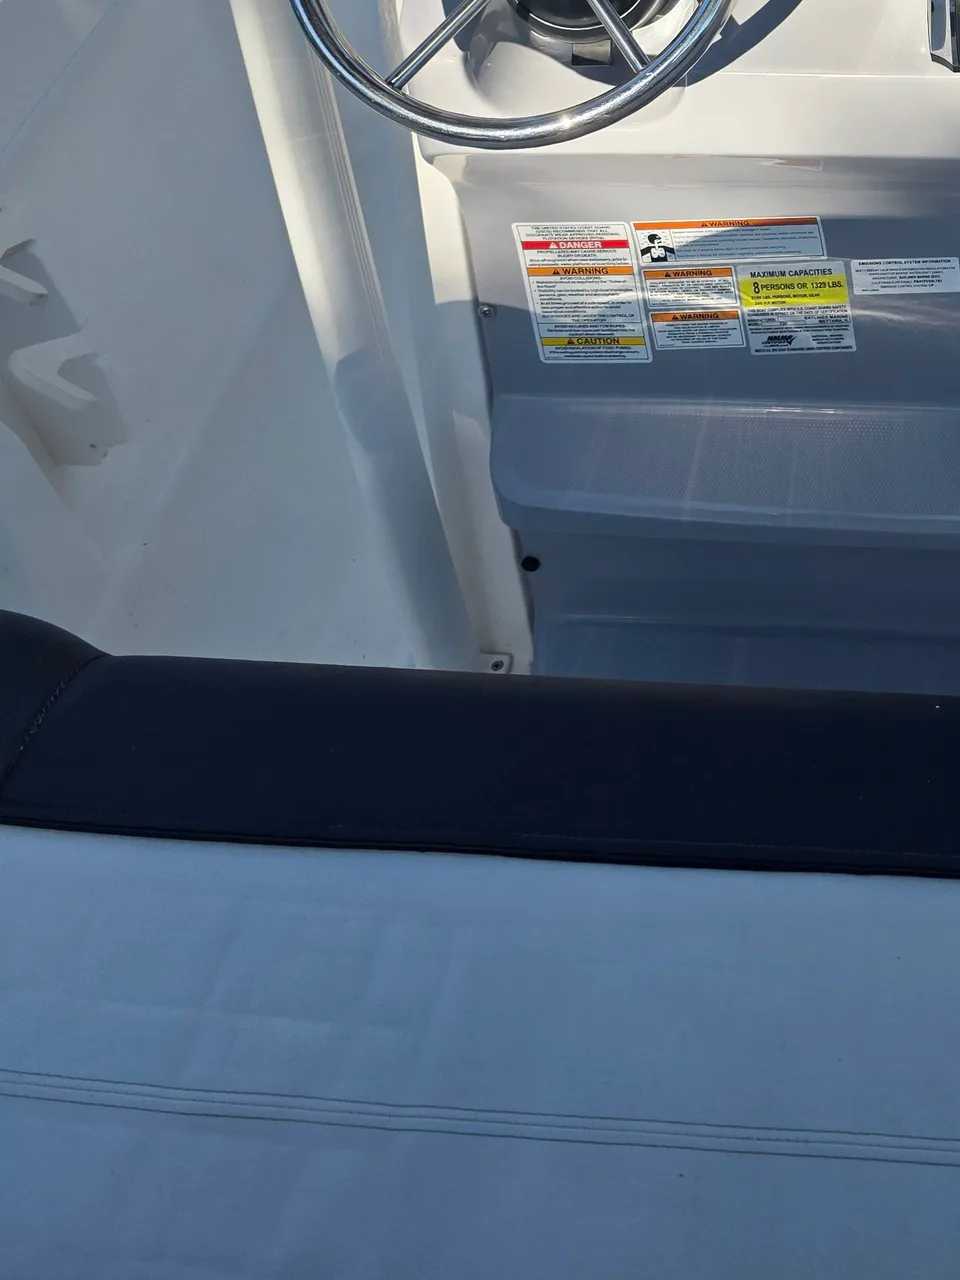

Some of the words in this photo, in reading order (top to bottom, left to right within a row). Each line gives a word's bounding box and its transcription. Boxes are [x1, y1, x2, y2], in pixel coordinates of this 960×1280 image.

[562, 267, 608, 275] WARNING
[789, 268, 833, 276] CAPACITIES
[753, 282, 760, 294] 8
[761, 283, 795, 291] PERSONS
[577, 337, 620, 345] CAUTION
